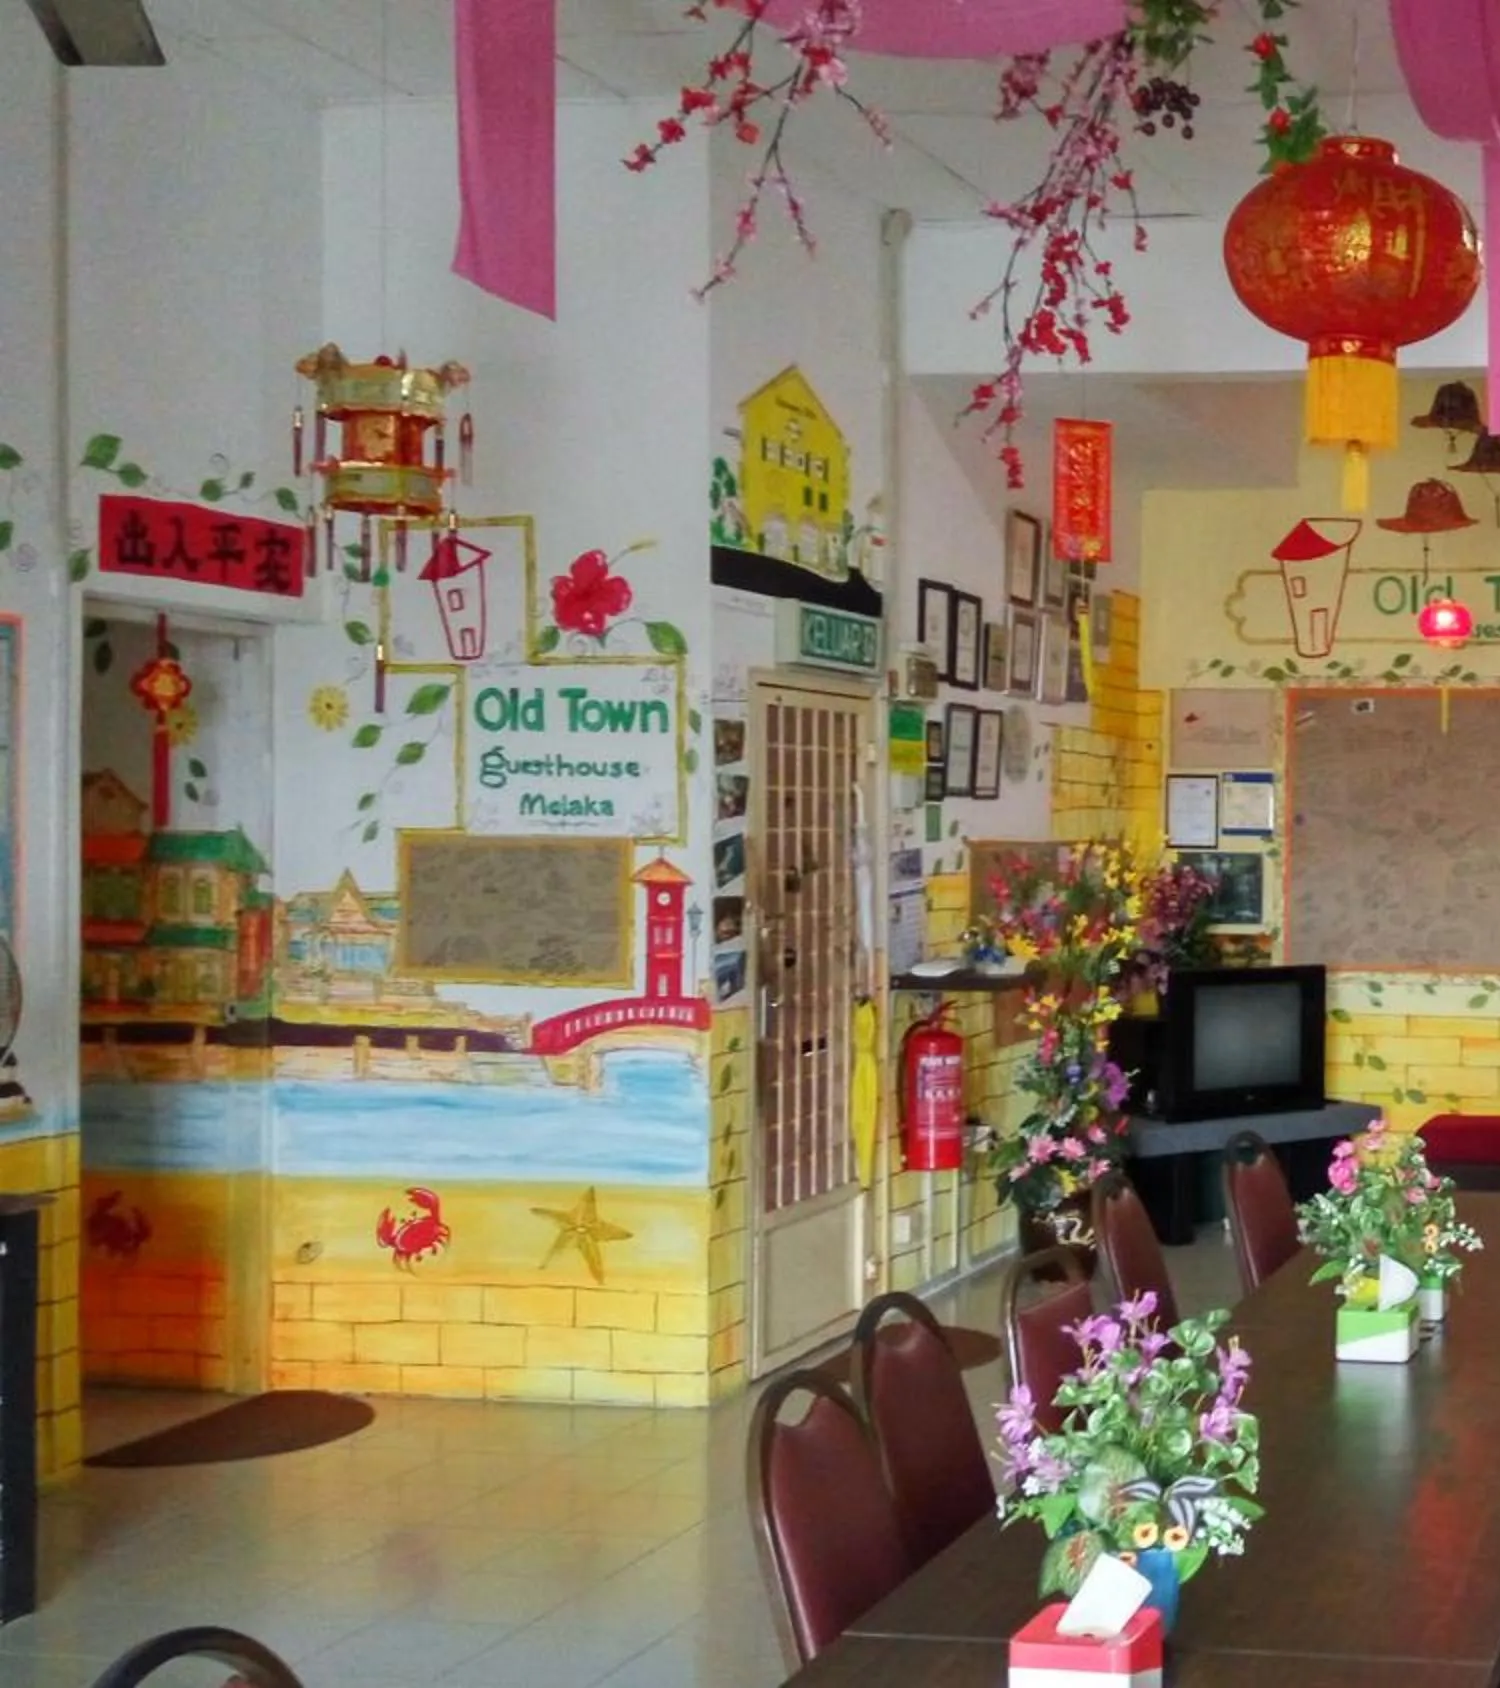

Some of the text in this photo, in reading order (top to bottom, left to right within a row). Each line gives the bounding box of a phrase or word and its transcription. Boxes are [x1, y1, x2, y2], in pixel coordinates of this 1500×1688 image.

[114, 508, 292, 593] 出入平安
[474, 686, 670, 733] Old Town
[479, 745, 641, 788] guesthouse
